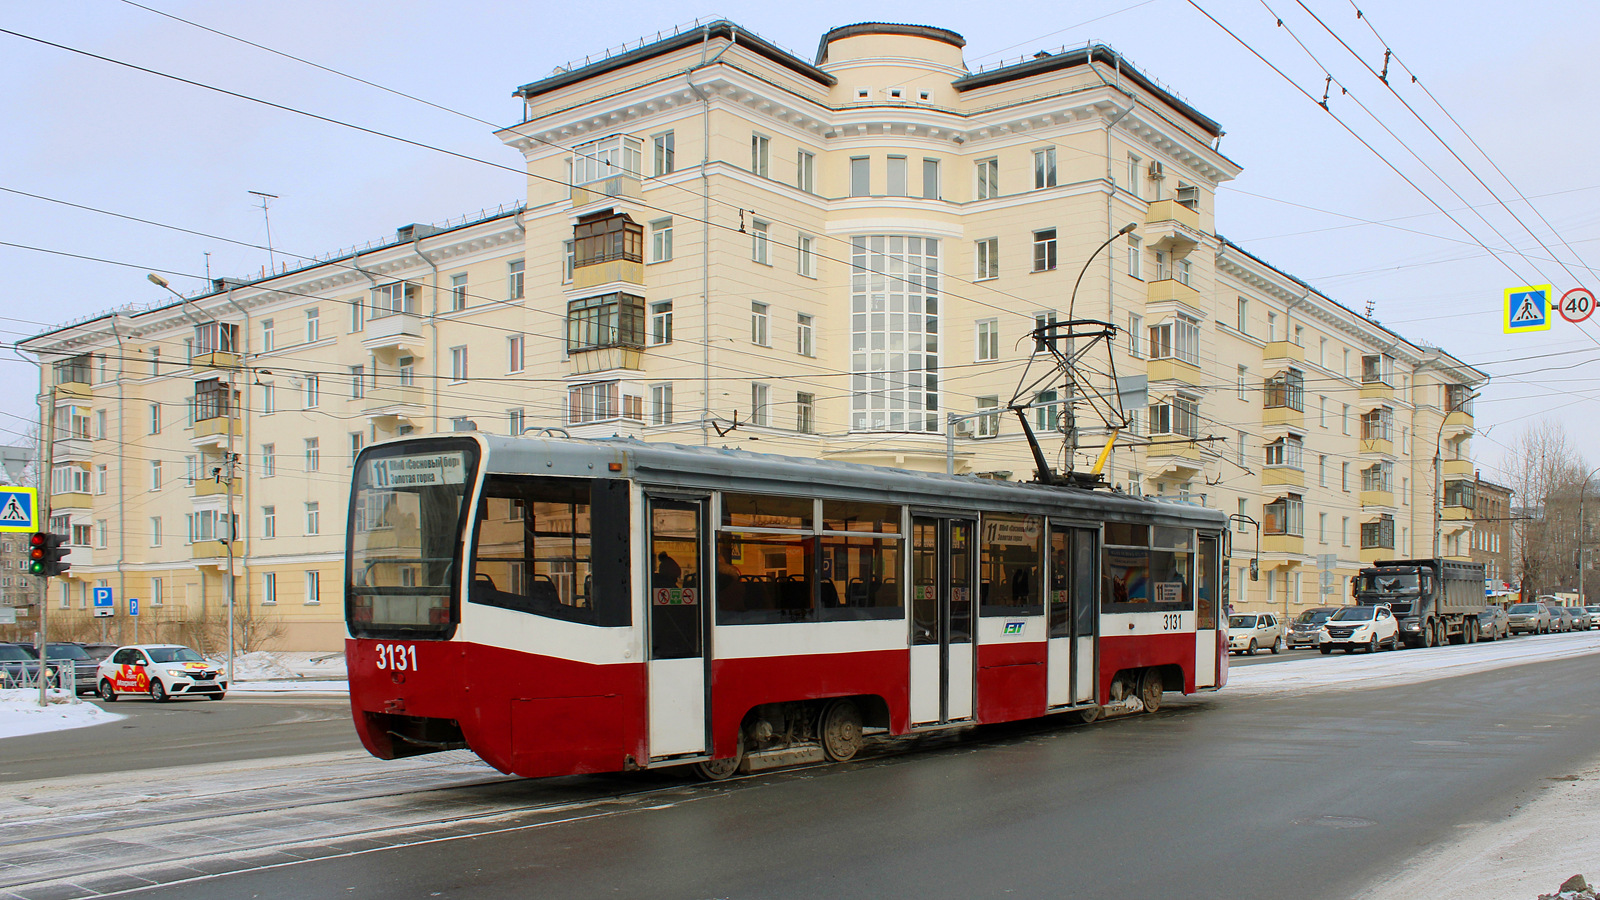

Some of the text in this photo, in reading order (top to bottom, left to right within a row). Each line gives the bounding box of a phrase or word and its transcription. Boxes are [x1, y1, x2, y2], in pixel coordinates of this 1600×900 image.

[1565, 297, 1588, 313] 40
[374, 460, 388, 486] 11
[390, 472, 435, 484] Золотая горка
[988, 523, 997, 541] 11
[97, 590, 109, 604] P
[1156, 584, 1163, 600] 11
[131, 601, 137, 613] P
[1163, 613, 1182, 630] 3131
[375, 643, 418, 671] 3131
